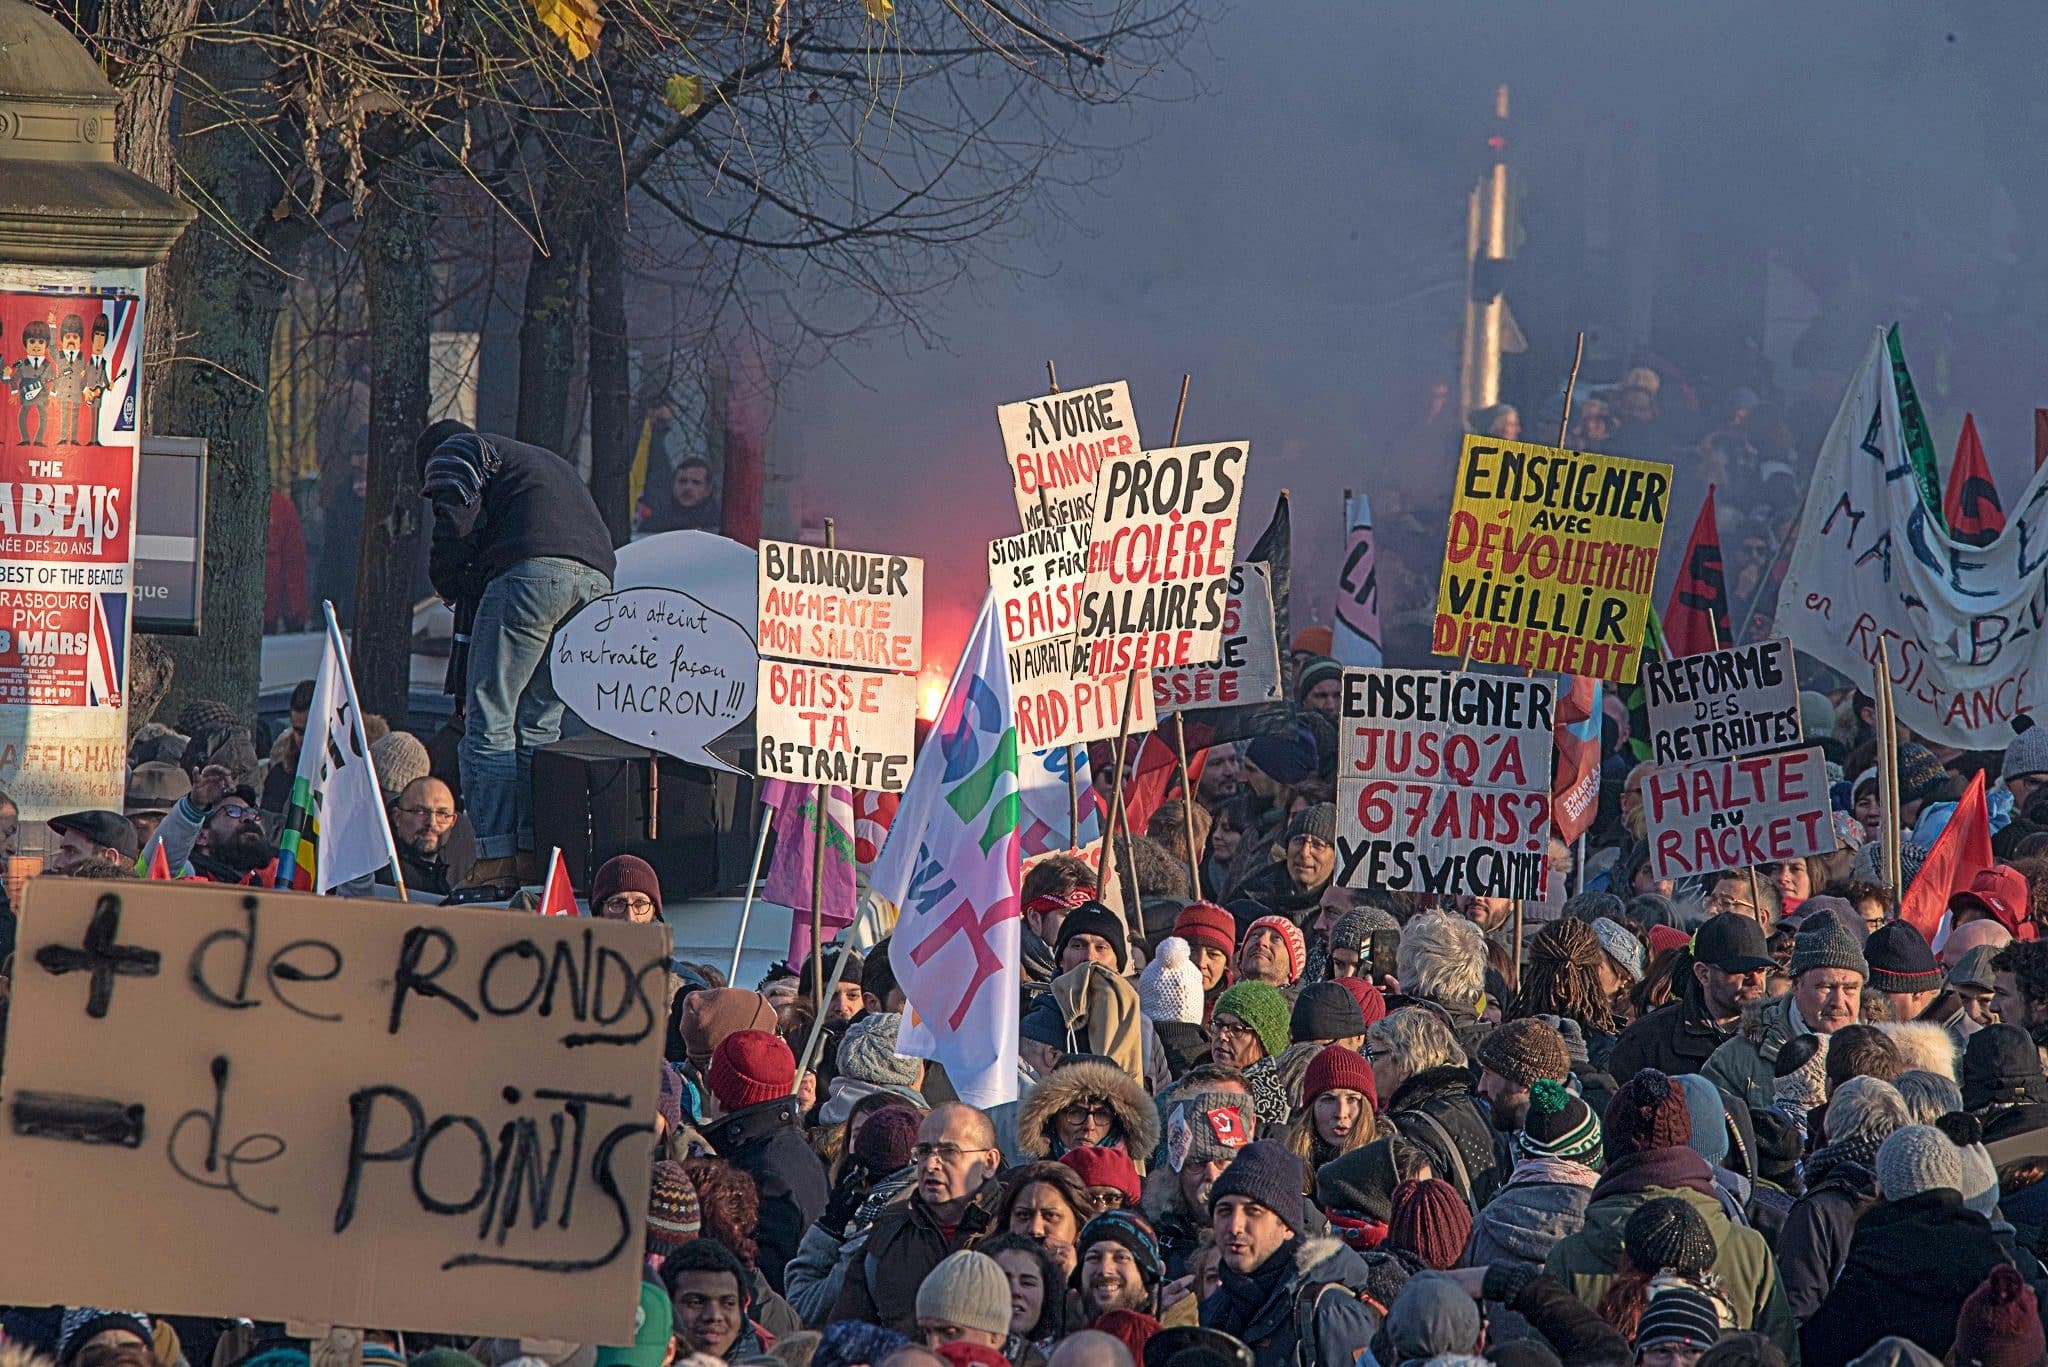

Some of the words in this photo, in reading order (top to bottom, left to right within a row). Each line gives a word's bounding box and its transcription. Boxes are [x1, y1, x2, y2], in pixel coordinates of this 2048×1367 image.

[1043, 389, 1123, 441] VOTRE
[28, 460, 64, 477] THE
[1104, 446, 1243, 522] PROFS
[1530, 510, 1592, 534] AVEC
[26, 540, 49, 553] DES
[53, 541, 68, 554] 20
[71, 541, 92, 555] ANS
[38, 568, 57, 583] OF
[61, 569, 84, 584] THE
[88, 569, 123, 585] BEATLES
[766, 544, 909, 597] BLANQUER
[1013, 565, 1034, 588] SE
[12, 609, 61, 630] PMC
[595, 597, 636, 631] J'ai
[647, 600, 708, 633] atteint
[765, 587, 891, 629] AUGMENTE
[18, 631, 88, 655] MARS
[581, 640, 658, 668] retraite
[760, 619, 800, 654] MON
[21, 655, 55, 667] 2020
[1648, 642, 1783, 707] REFORME
[1014, 689, 1069, 746] RAD
[1695, 693, 1740, 720] DES
[799, 712, 851, 753] TA
[1650, 753, 1809, 823] HALTE
[1711, 810, 1743, 829] AU
[1657, 810, 1823, 877] RACKET
[1335, 836, 1415, 891] YES
[190, 895, 343, 1021] de
[388, 926, 672, 1047] RONDS
[167, 1056, 286, 1213] de
